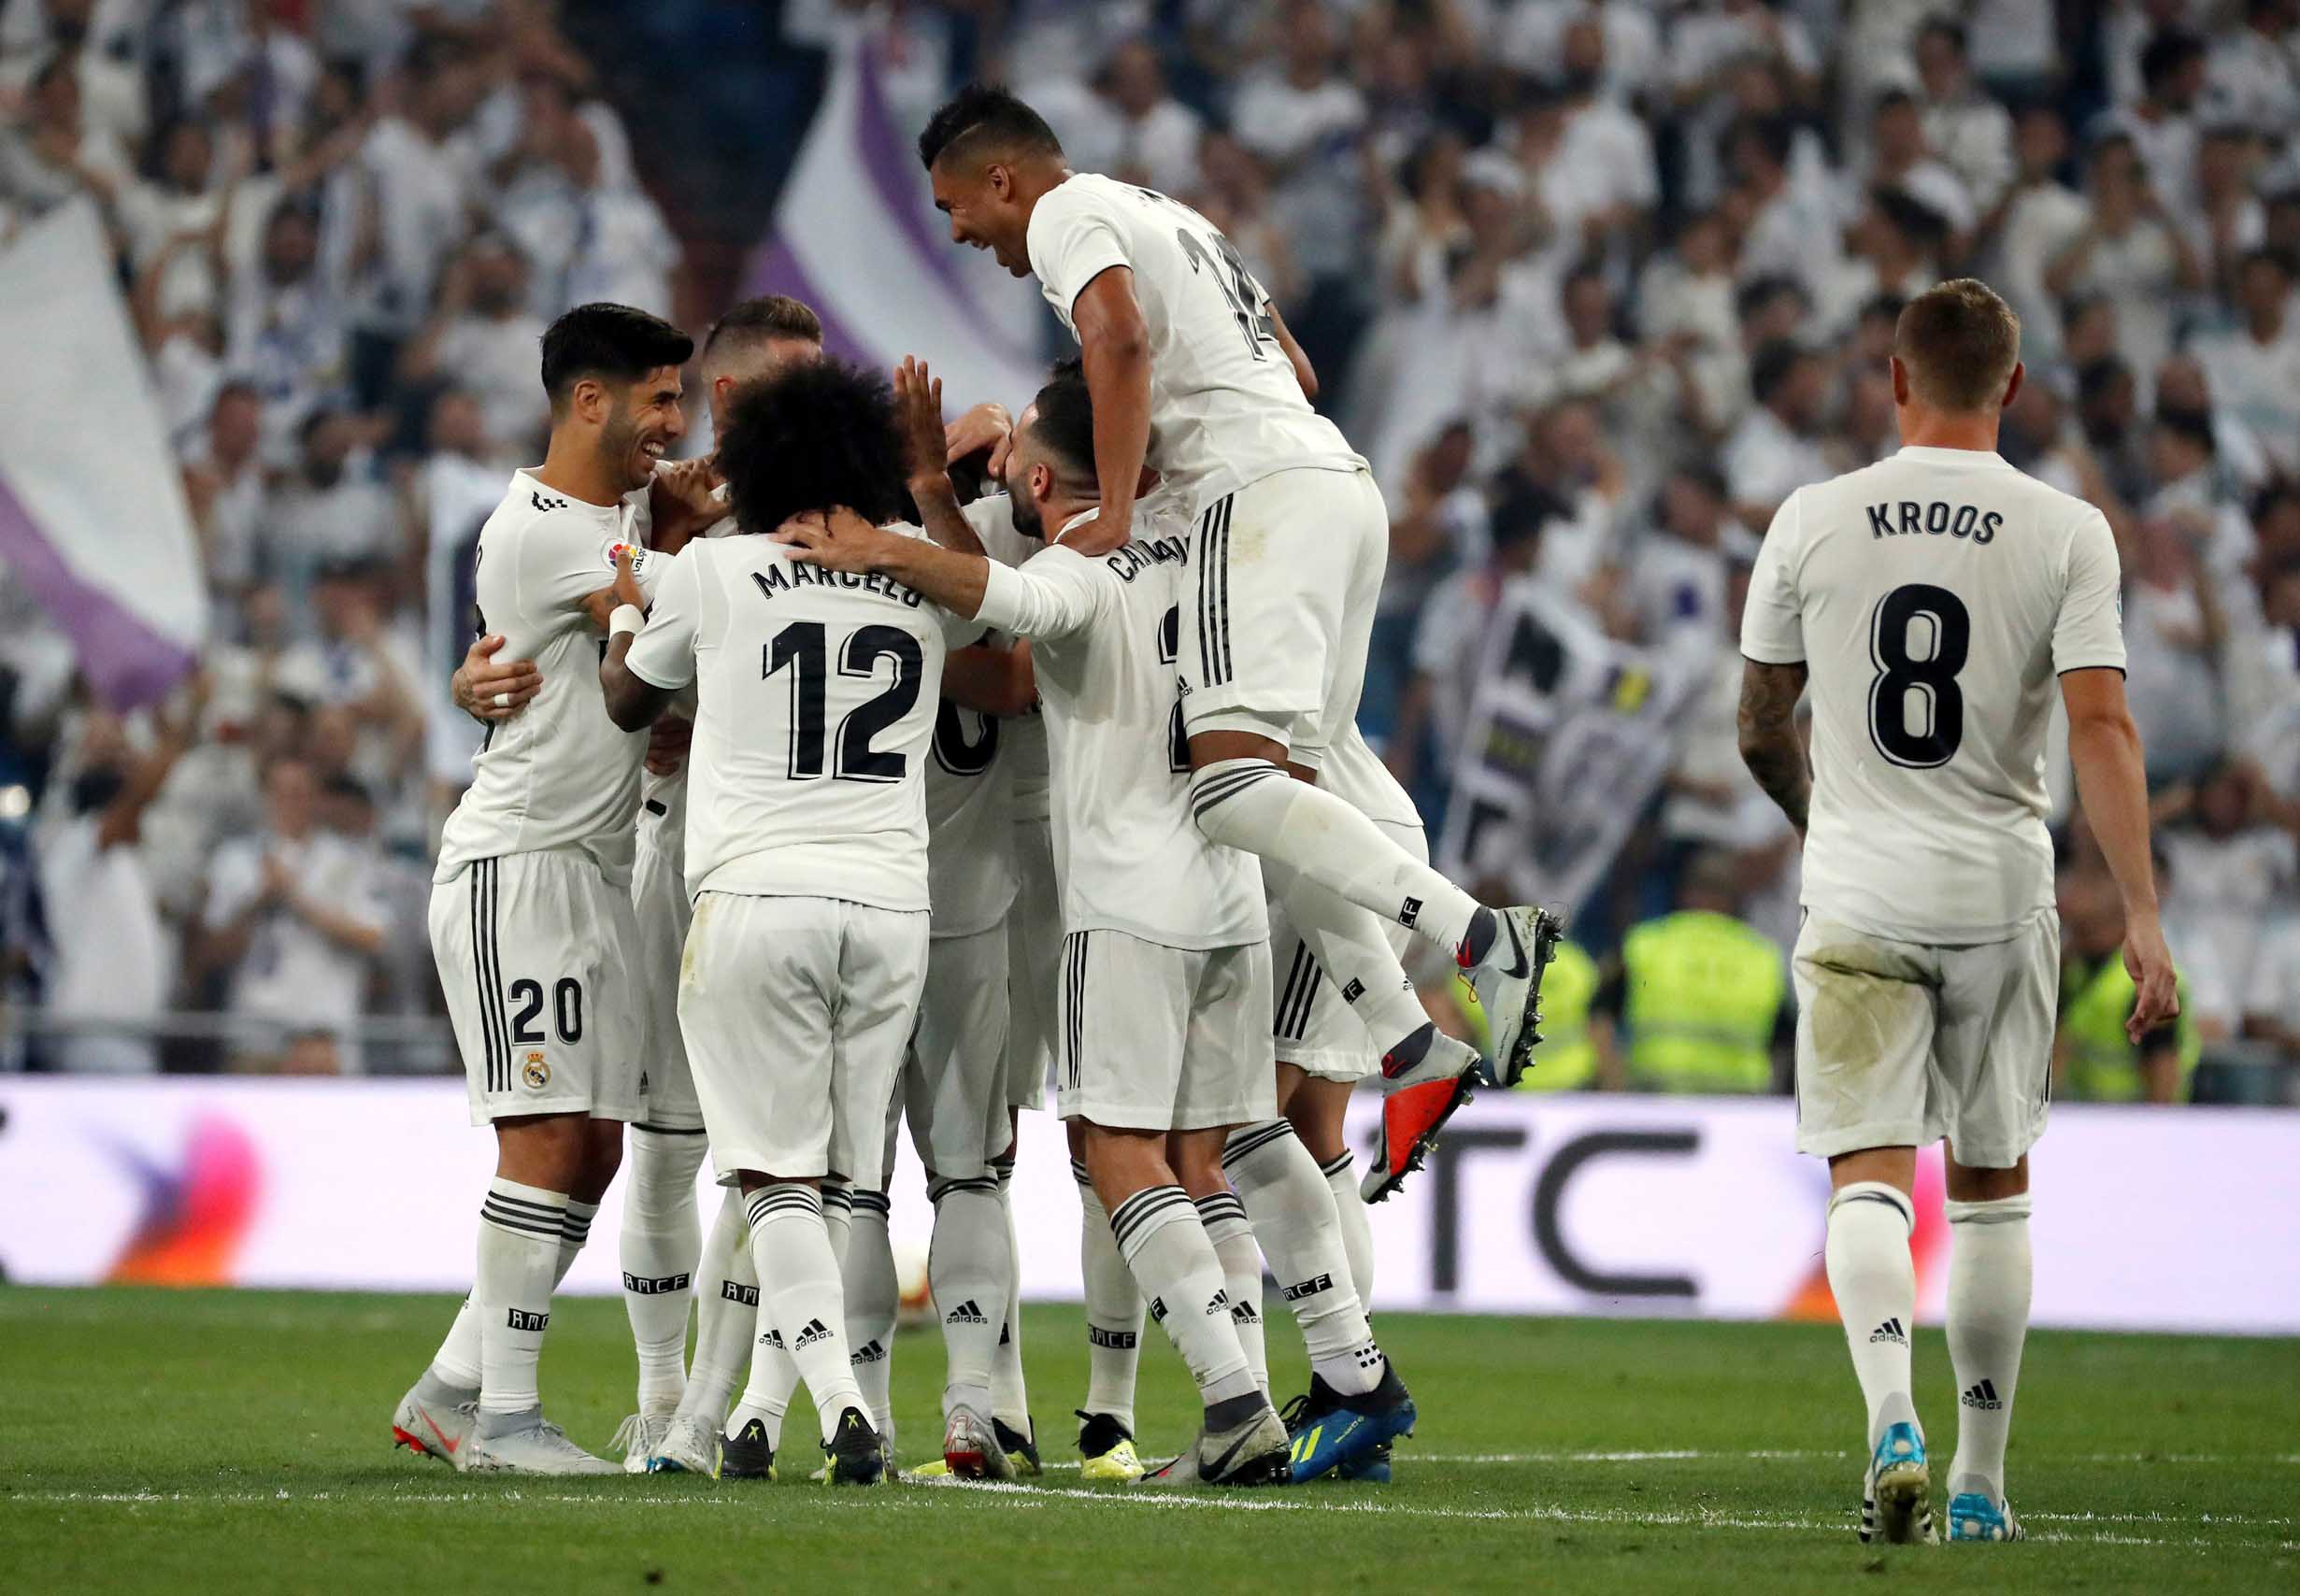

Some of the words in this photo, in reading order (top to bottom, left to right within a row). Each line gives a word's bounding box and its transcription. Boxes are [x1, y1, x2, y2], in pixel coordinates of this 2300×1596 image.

[1865, 501, 2004, 545] KROOS
[1868, 583, 1970, 770] 8
[762, 621, 923, 784] 12
[508, 977, 582, 1047] 20
[623, 1273, 688, 1294] RMCF
[726, 1282, 758, 1304] RM
[1283, 1275, 1328, 1300] MCF
[946, 1315, 988, 1325] adidas
[795, 1330, 835, 1352] adidas
[1962, 1395, 2003, 1411] adidas
